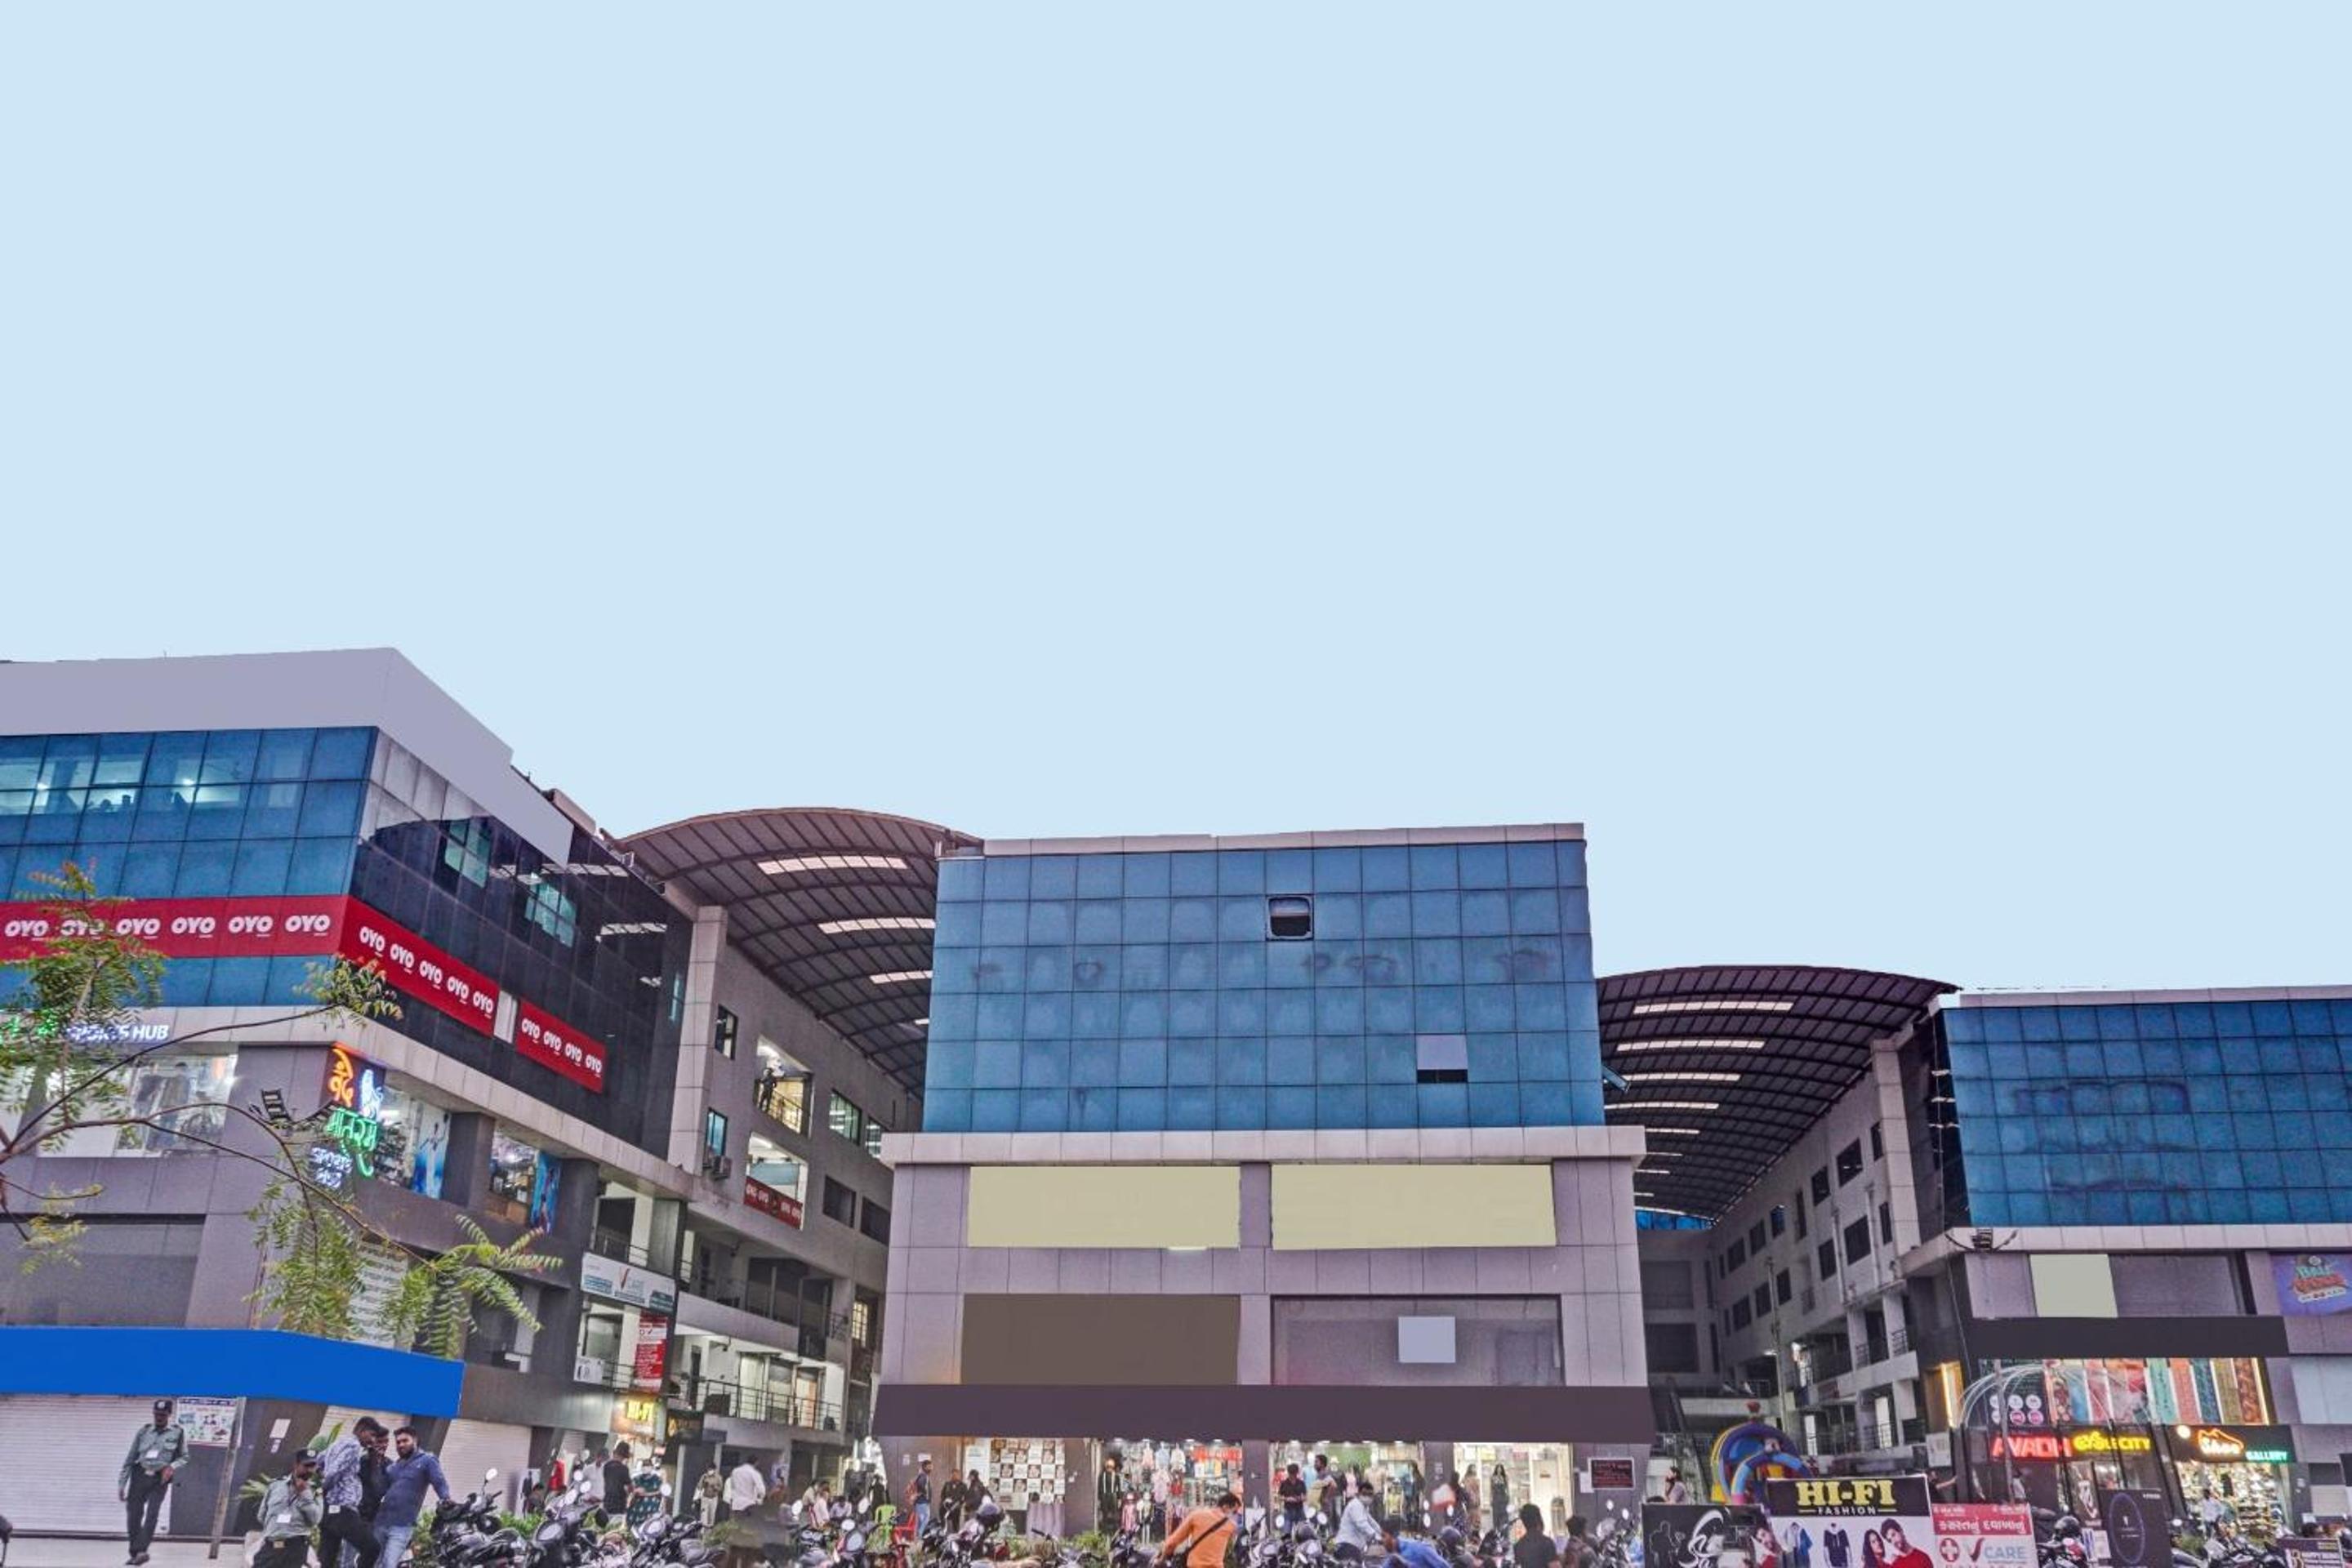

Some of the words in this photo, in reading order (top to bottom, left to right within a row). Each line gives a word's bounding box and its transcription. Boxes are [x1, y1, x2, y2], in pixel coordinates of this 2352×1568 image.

[4, 919, 49, 938] OYO
[116, 917, 161, 936] OYO
[171, 915, 216, 934] OYO
[228, 915, 274, 933] OYO
[285, 914, 331, 933] OYO
[359, 925, 385, 951] OYO
[390, 943, 415, 969] OYO
[419, 960, 443, 985] OYO
[447, 975, 470, 1000] OYO
[473, 991, 493, 1014] OYO
[131, 1024, 170, 1040] HUB
[521, 1018, 541, 1039] OYO
[543, 1030, 562, 1051] OYO
[565, 1043, 582, 1062] OYO
[586, 1054, 603, 1073] OYO
[2118, 1437, 2150, 1450] CITY
[1796, 1481, 1896, 1506] HI-FI
[1818, 1506, 1877, 1516] FASHION
